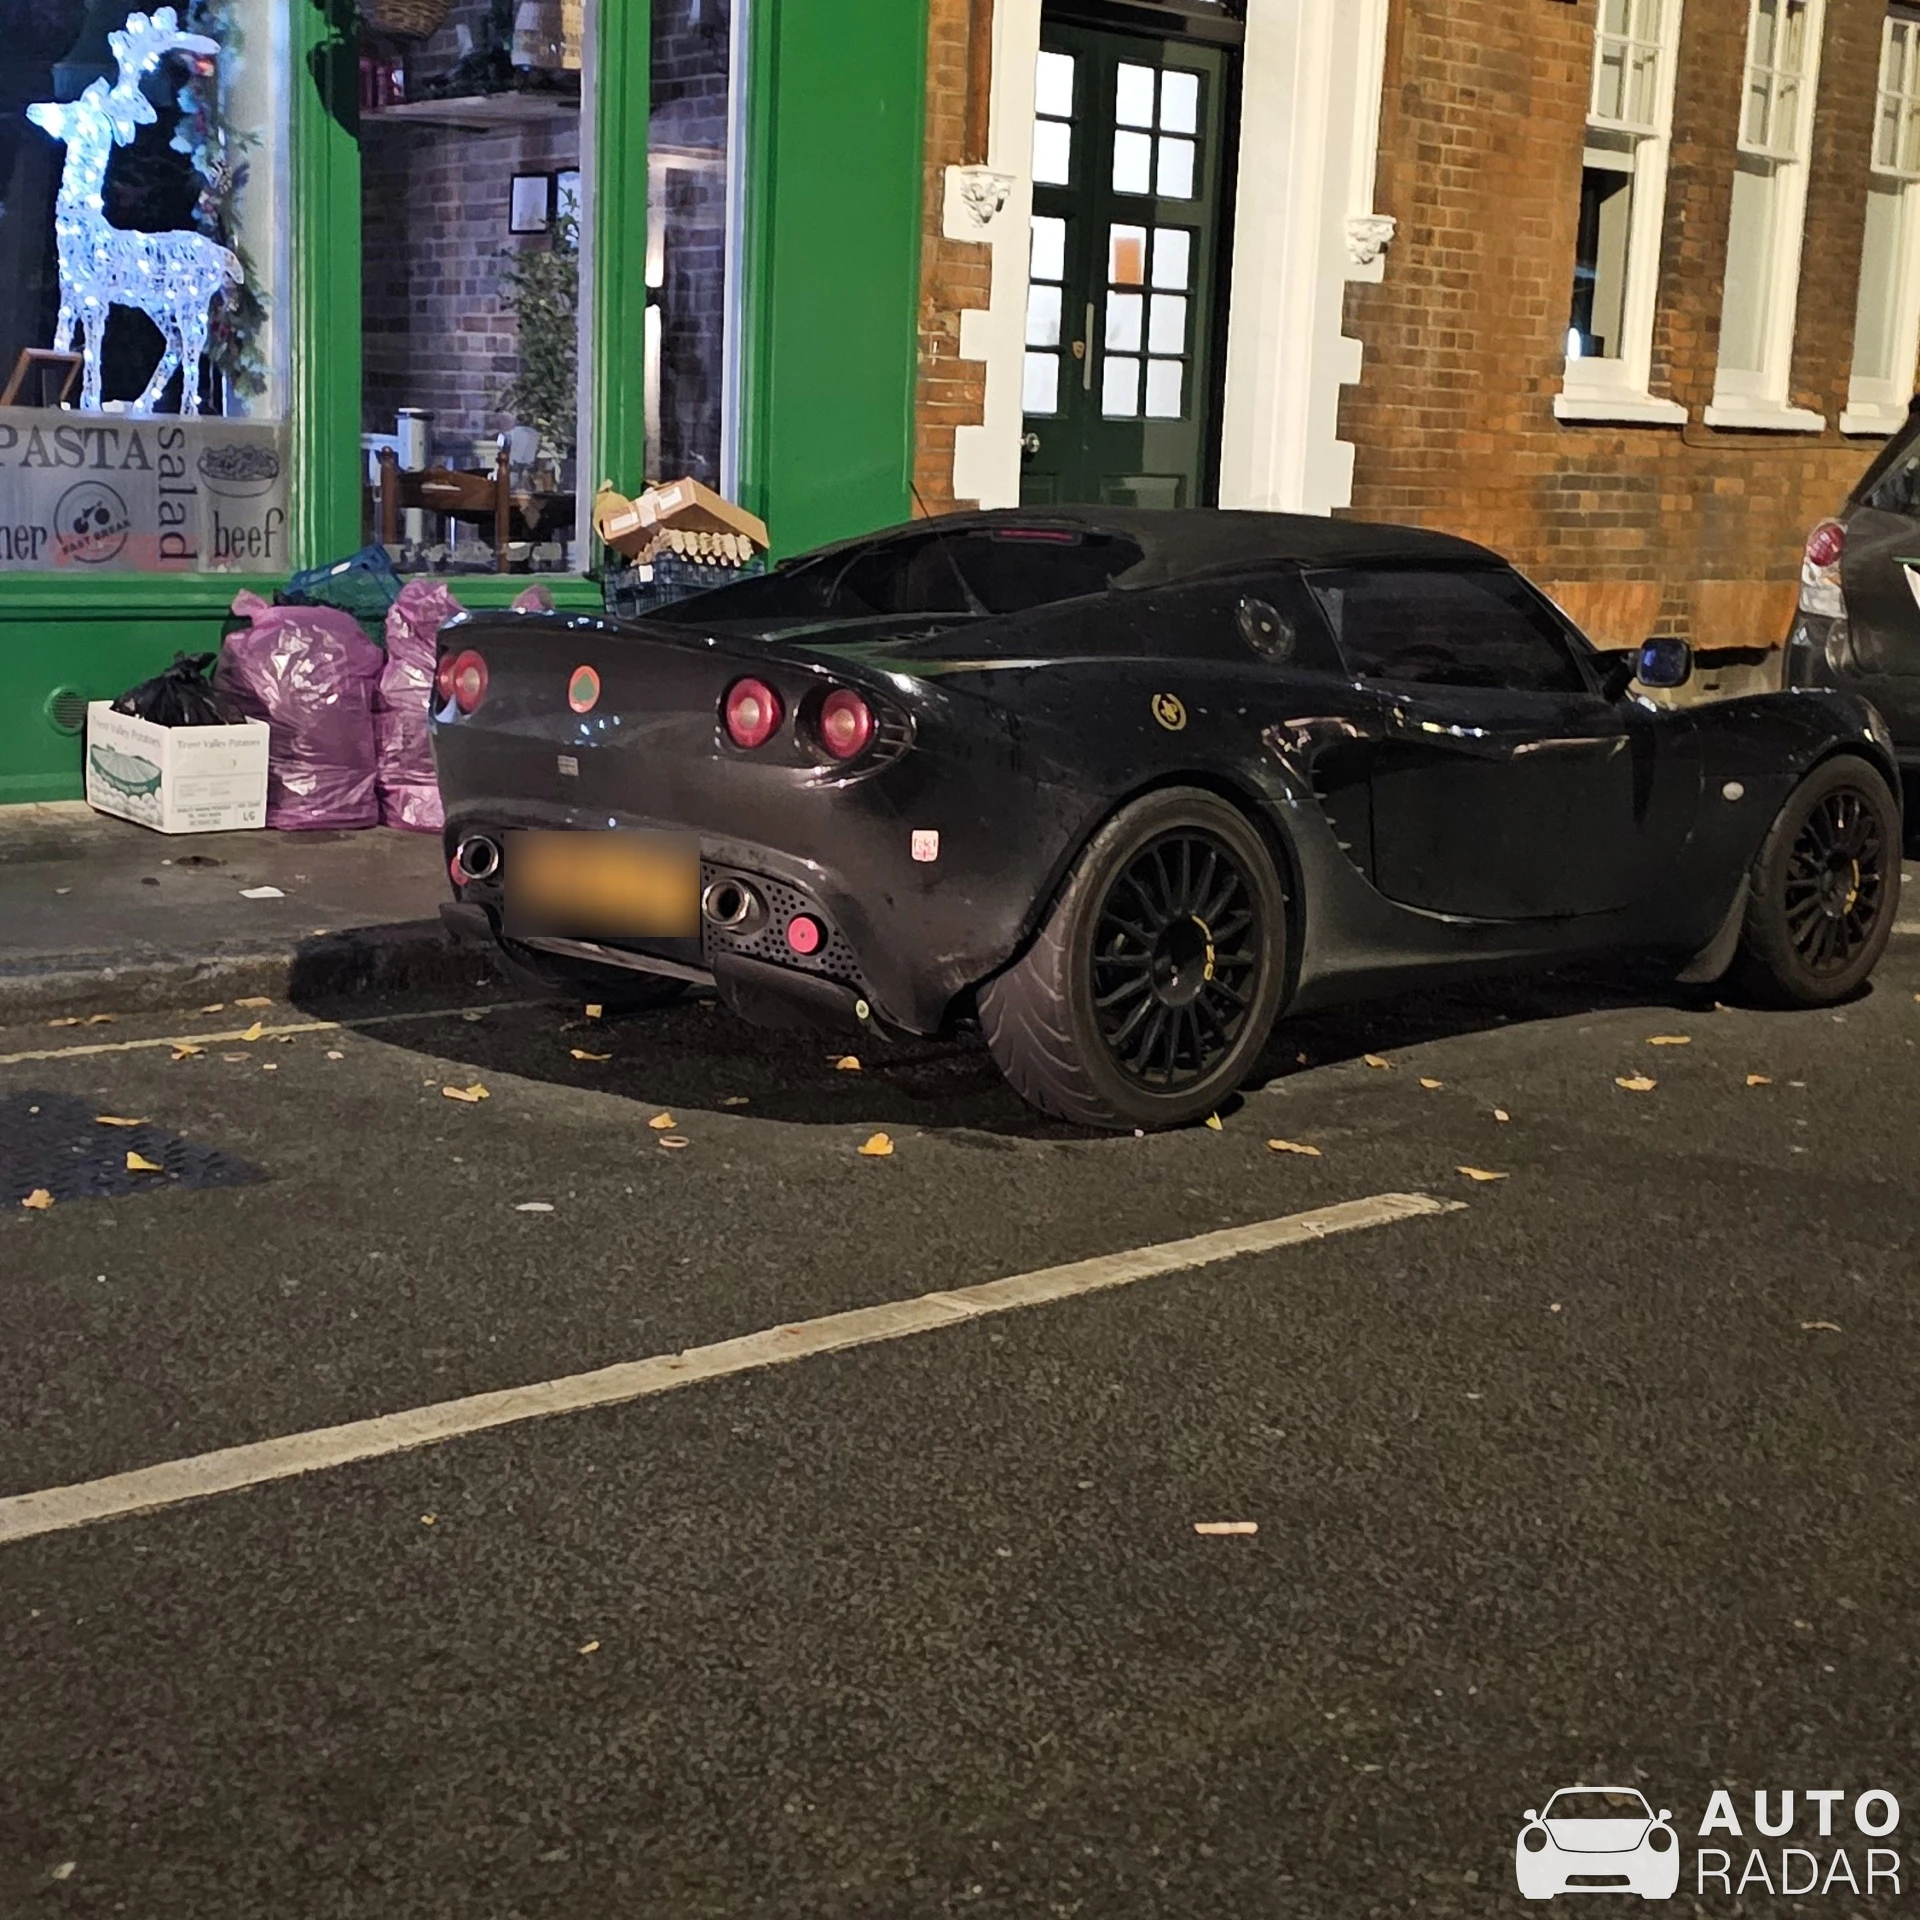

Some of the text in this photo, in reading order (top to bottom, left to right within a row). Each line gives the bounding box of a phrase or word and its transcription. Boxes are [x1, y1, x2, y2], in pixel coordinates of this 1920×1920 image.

[0, 424, 153, 470] PASTA
[157, 426, 199, 560] salad
[62, 519, 132, 556] FAST BREAK
[213, 507, 284, 558] beef
